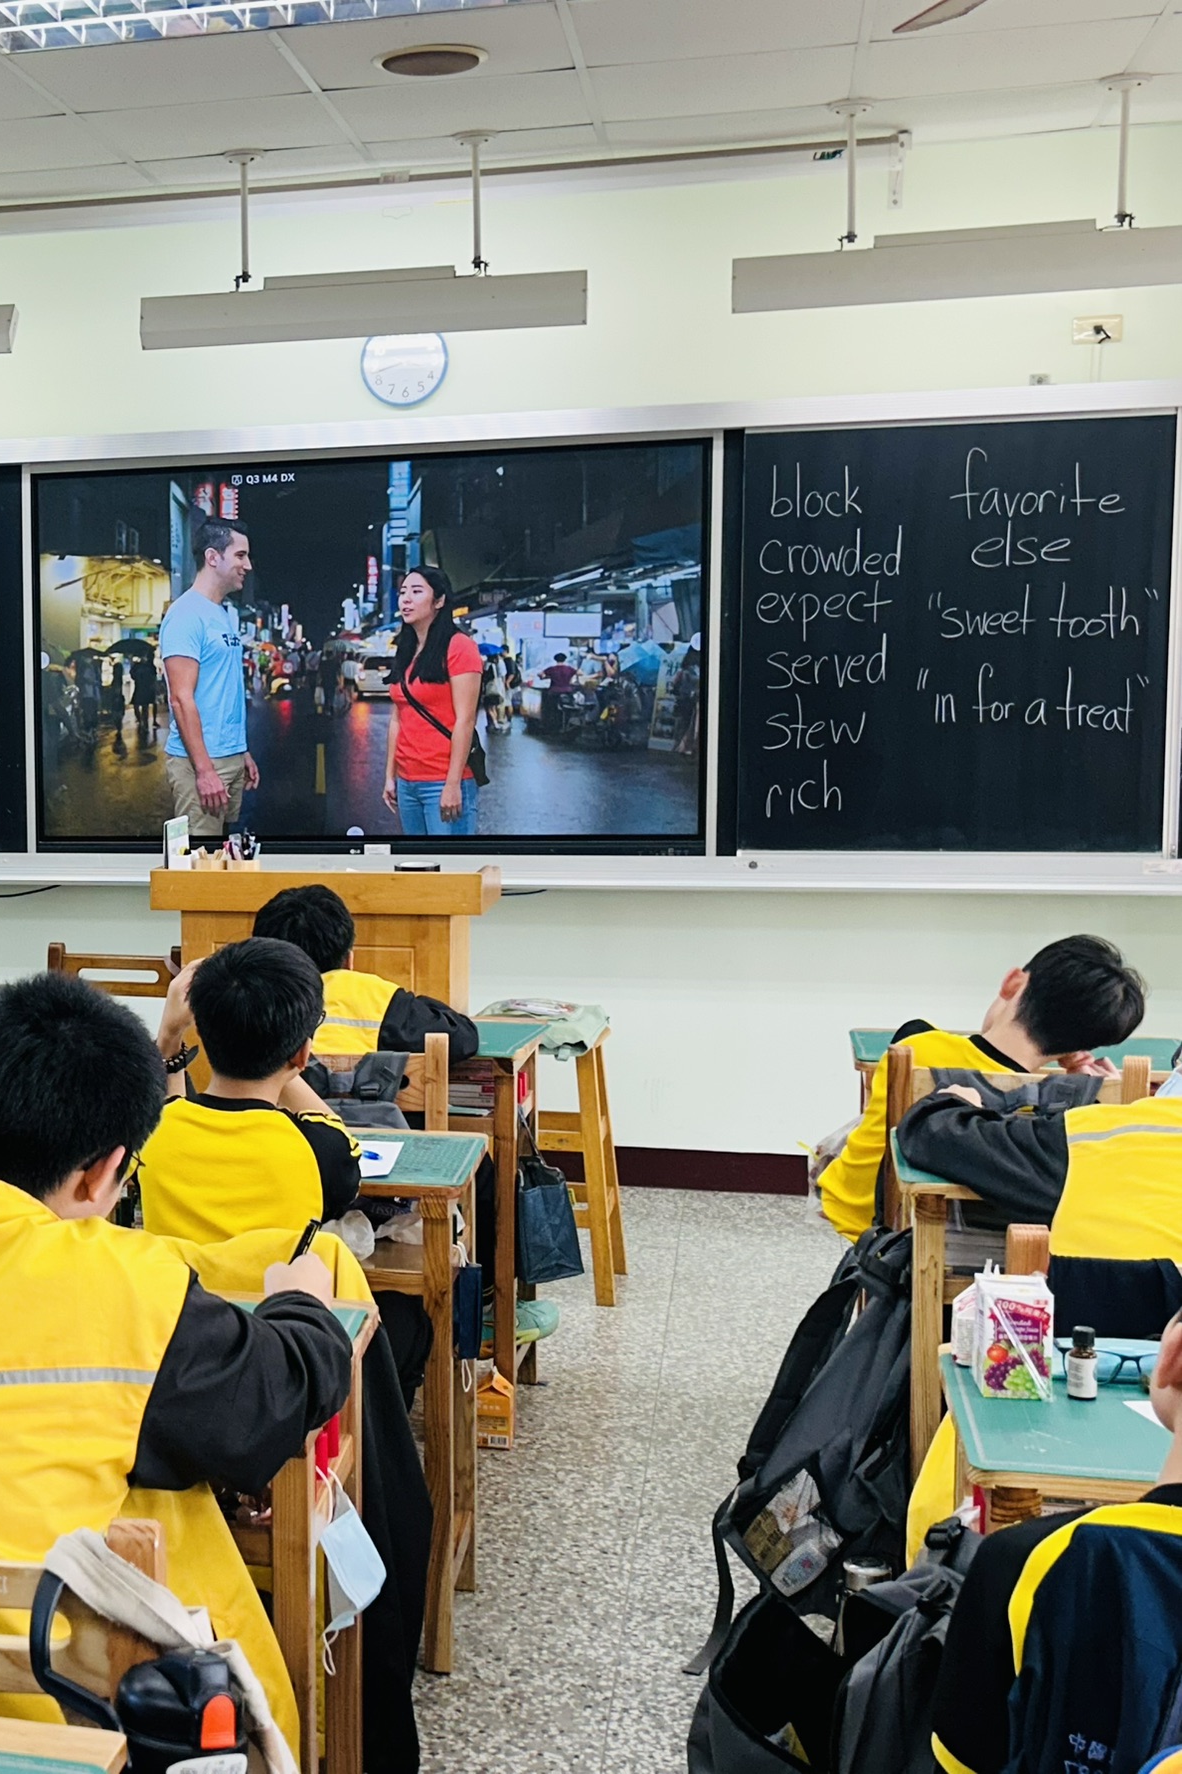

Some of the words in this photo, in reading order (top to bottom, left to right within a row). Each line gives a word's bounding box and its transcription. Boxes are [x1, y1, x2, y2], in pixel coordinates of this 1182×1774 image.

[246, 474, 259, 485] Q3
[262, 473, 278, 483] M4
[280, 472, 295, 482] DX
[771, 462, 862, 518] block
[950, 447, 1125, 519] favorite
[760, 525, 902, 576] crowded
[971, 520, 1071, 567] else
[755, 580, 893, 642] expect
[767, 632, 887, 690] served
[762, 694, 866, 750] stew
[972, 663, 1015, 723] for
[1024, 698, 1047, 726] a
[766, 759, 842, 818] rich
